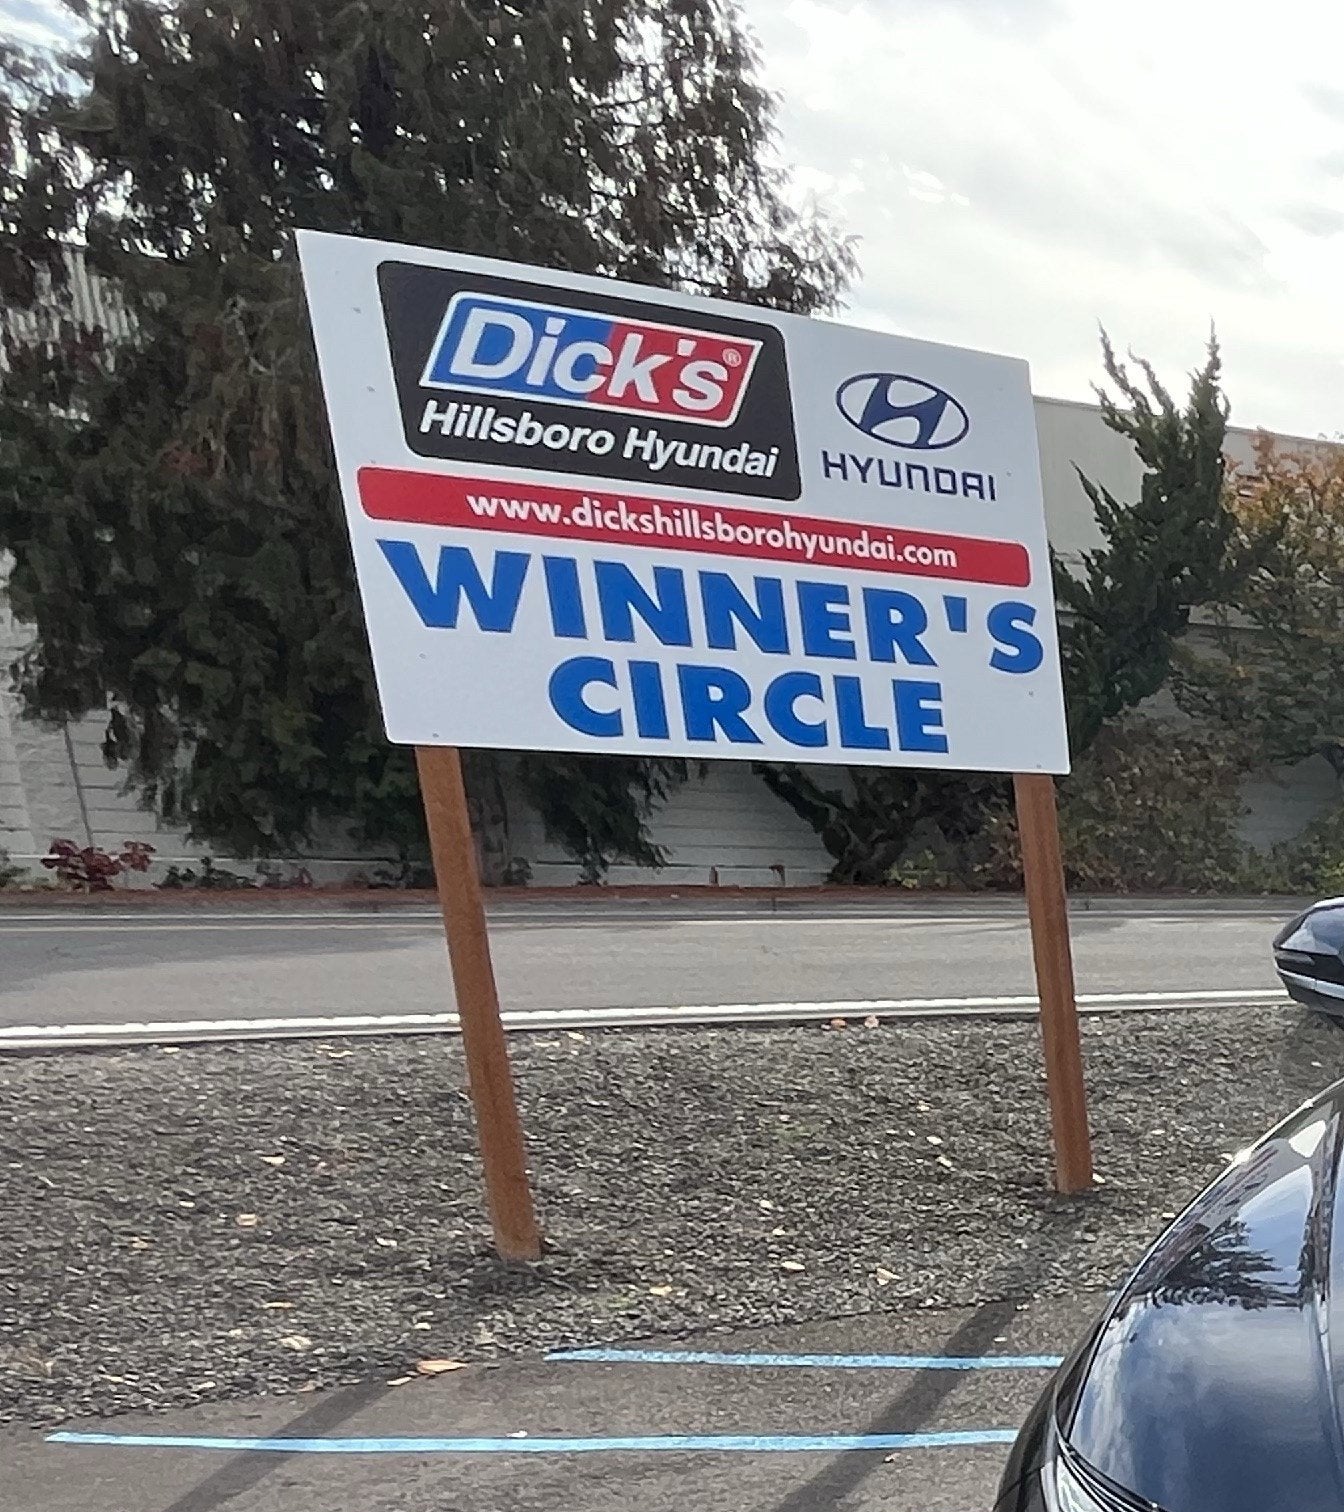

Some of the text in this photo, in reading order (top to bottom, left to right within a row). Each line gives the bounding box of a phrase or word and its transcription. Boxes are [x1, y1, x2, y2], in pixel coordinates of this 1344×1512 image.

[420, 400, 780, 479] Hillsboro Hyundai
[821, 451, 996, 502] HYUNDAI
[466, 490, 957, 569] www.dickshillsborohyundai.com
[376, 538, 1044, 674] WINNER'S
[548, 656, 950, 754] CIRCLE
